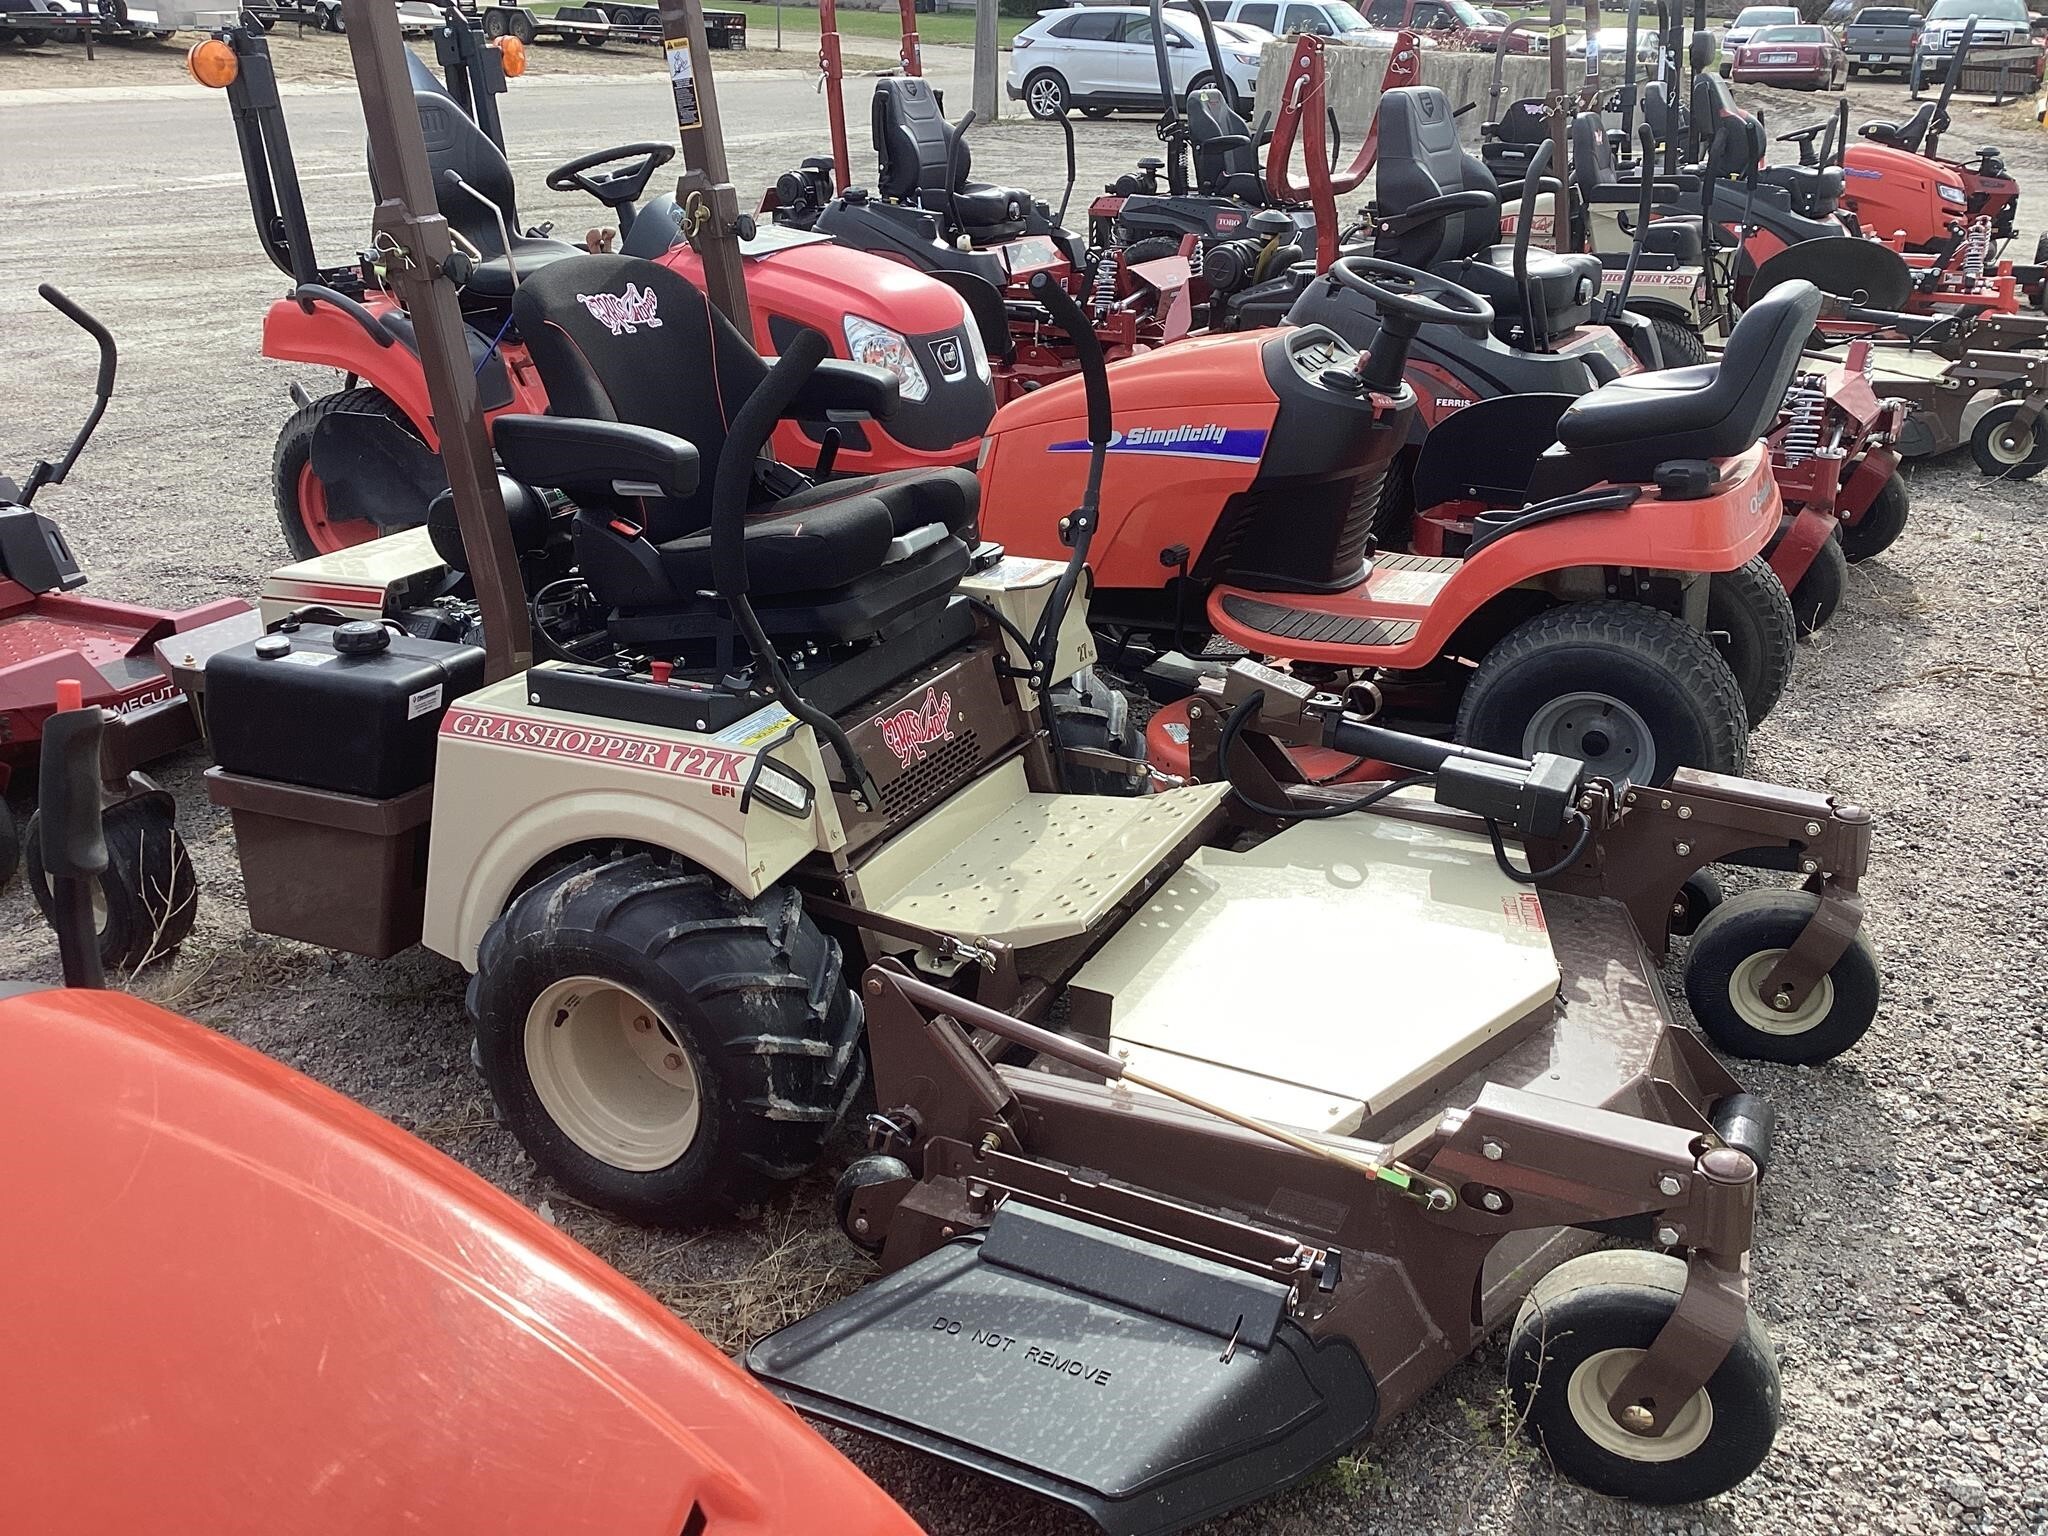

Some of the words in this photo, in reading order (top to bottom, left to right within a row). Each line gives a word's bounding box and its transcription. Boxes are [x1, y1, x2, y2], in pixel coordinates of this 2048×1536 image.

[1663, 274, 1694, 285] 725D
[1436, 398, 1471, 408] FERRIS
[1125, 423, 1228, 447] Simplicity
[453, 714, 663, 767] GRASSHOPPER
[670, 745, 747, 783] 727K
[711, 784, 736, 798] EFI
[932, 1316, 962, 1335] DO
[971, 1328, 1016, 1352] NOT
[1024, 1345, 1112, 1387] REMOVE
